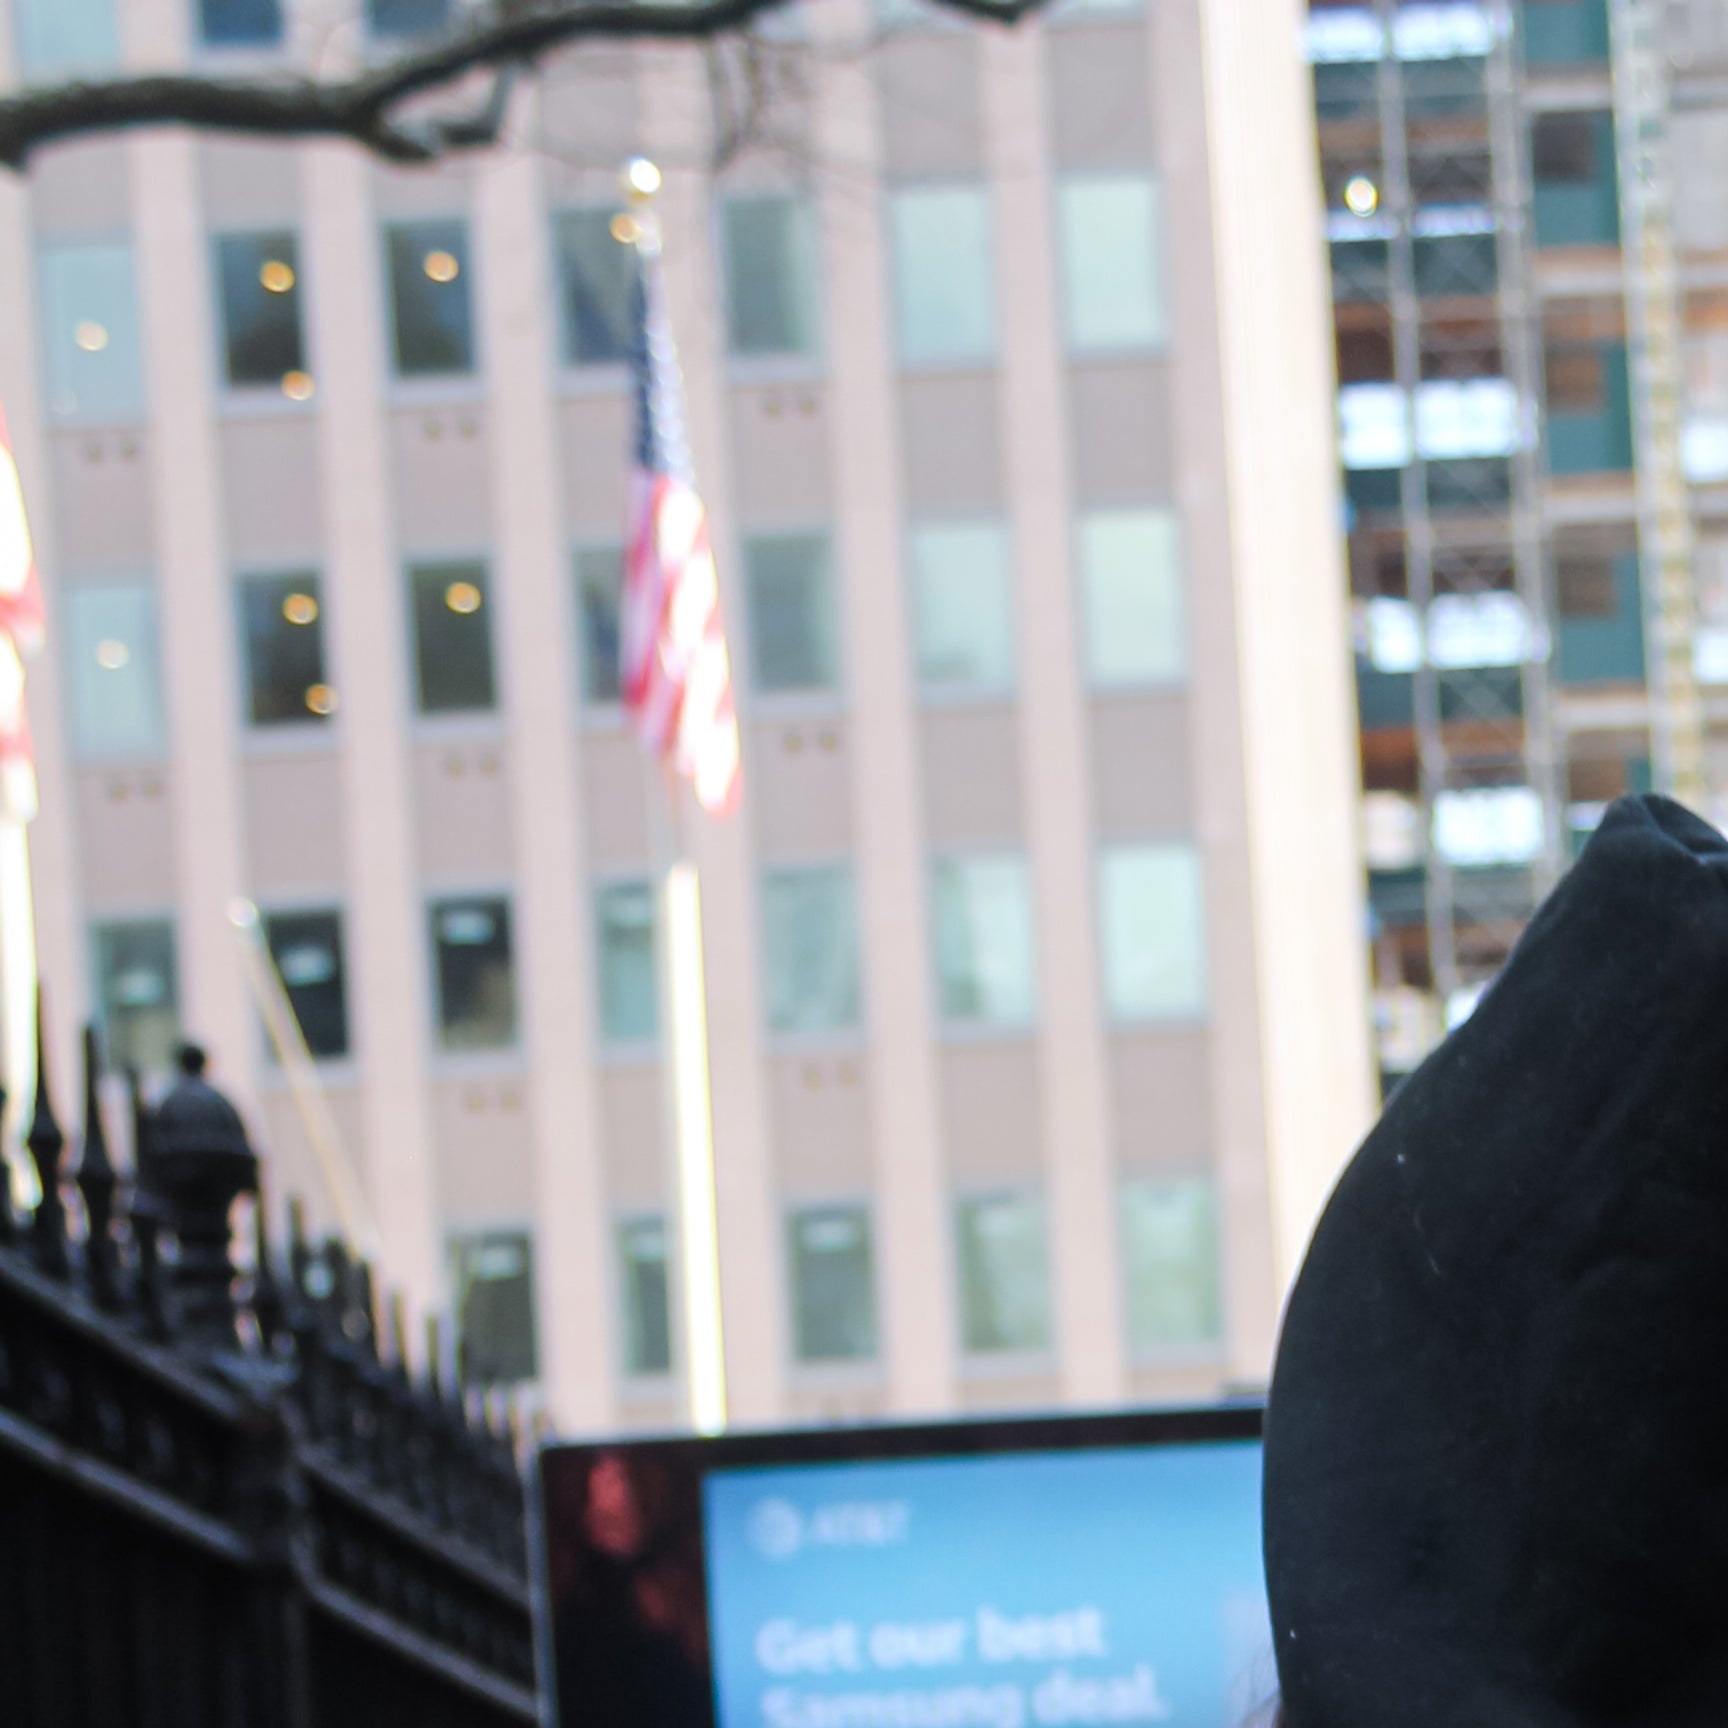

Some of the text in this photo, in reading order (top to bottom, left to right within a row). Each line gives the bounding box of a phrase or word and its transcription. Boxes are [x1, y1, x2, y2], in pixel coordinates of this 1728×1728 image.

[756, 1602, 1108, 1675] Get our best
